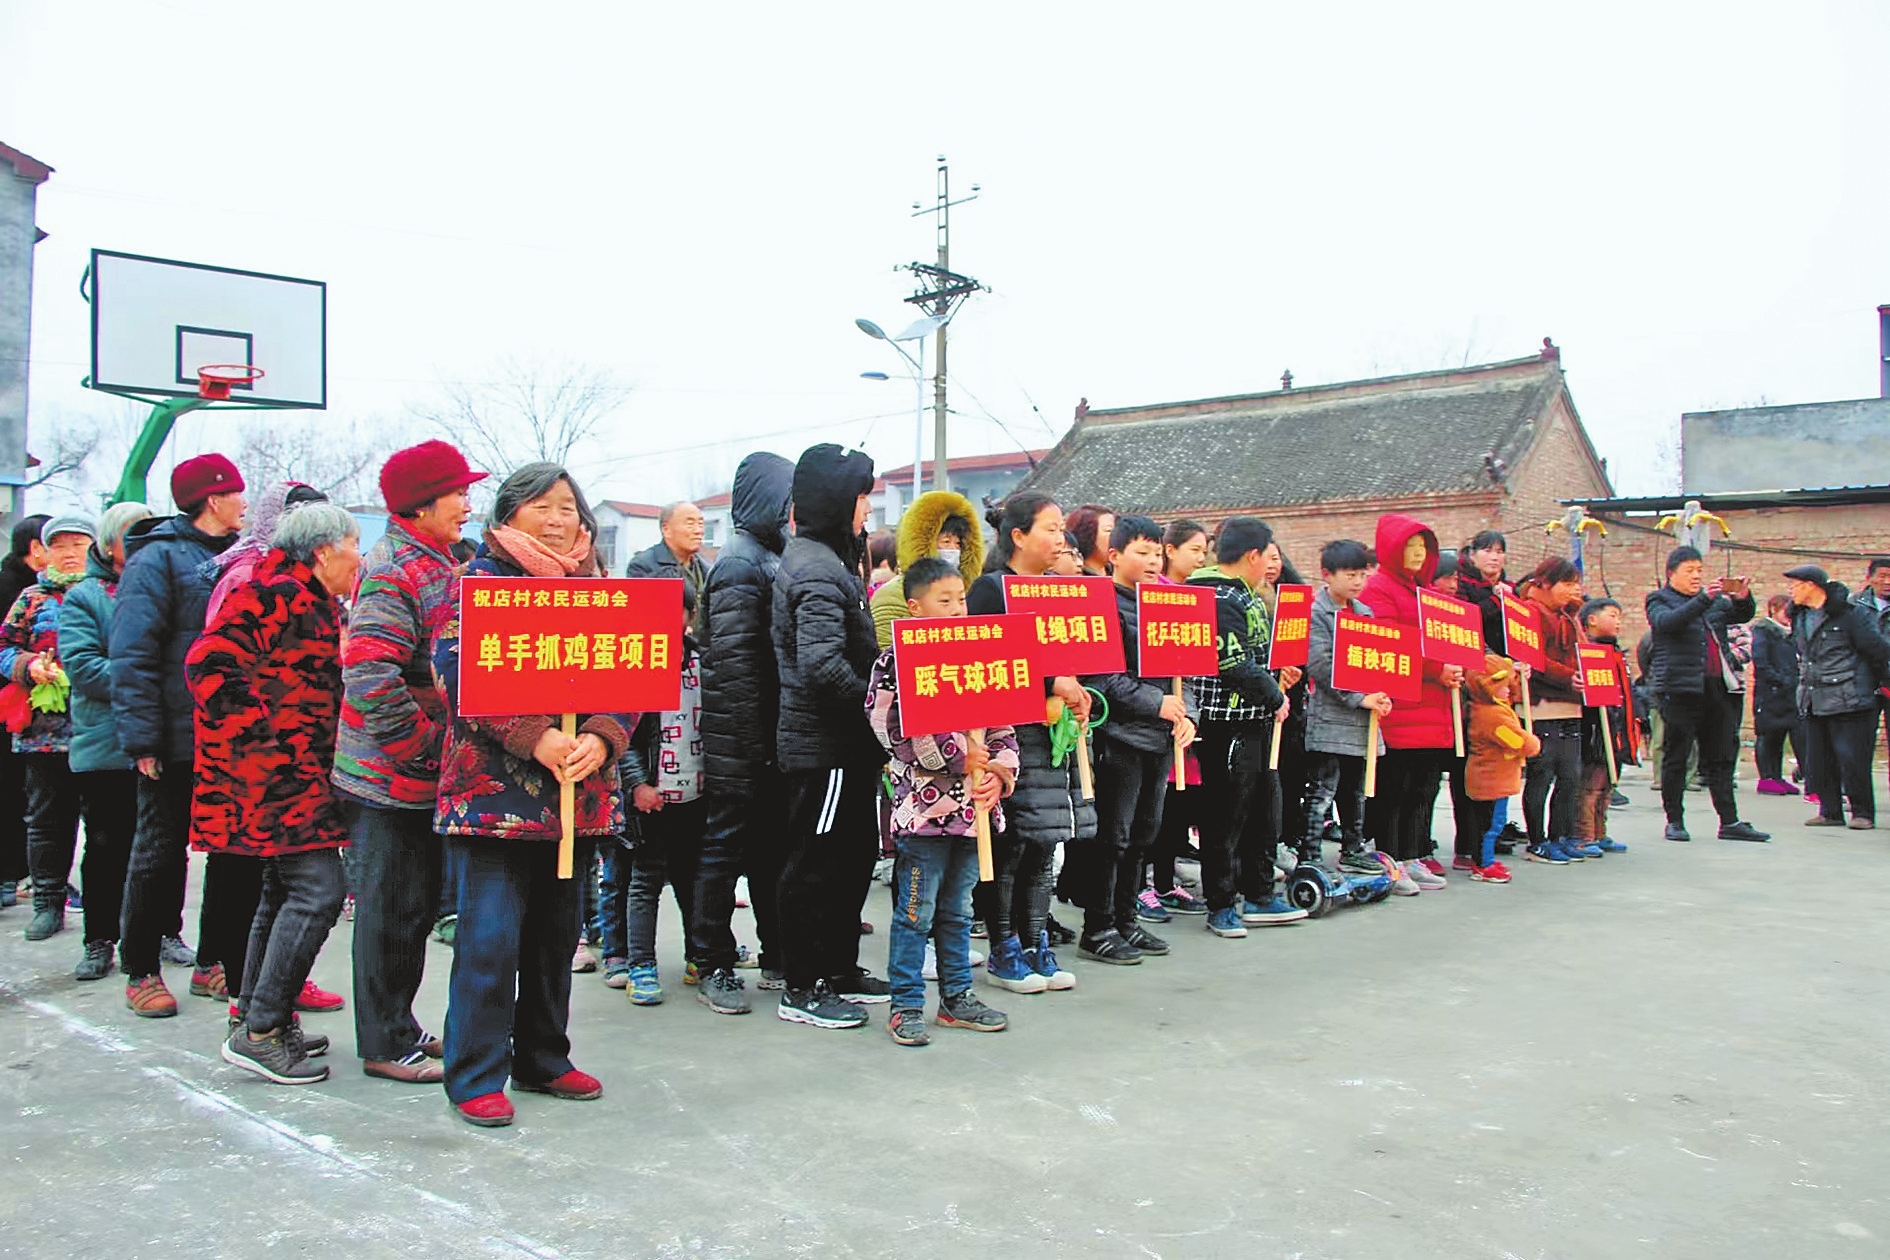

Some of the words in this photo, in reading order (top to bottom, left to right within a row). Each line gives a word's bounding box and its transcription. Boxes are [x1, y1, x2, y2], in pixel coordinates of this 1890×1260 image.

[472, 589, 629, 608] 祝店村农民运动会
[1009, 583, 1088, 598] 祝店村农民运动会
[901, 623, 1004, 646] 祝店村农民运动会
[1146, 621, 1212, 647] 托乒乓球项目
[476, 633, 670, 672] 单手抓鸡蛋项目
[1346, 644, 1411, 677] 插秧项目
[914, 658, 1031, 698] 踩气球项目
